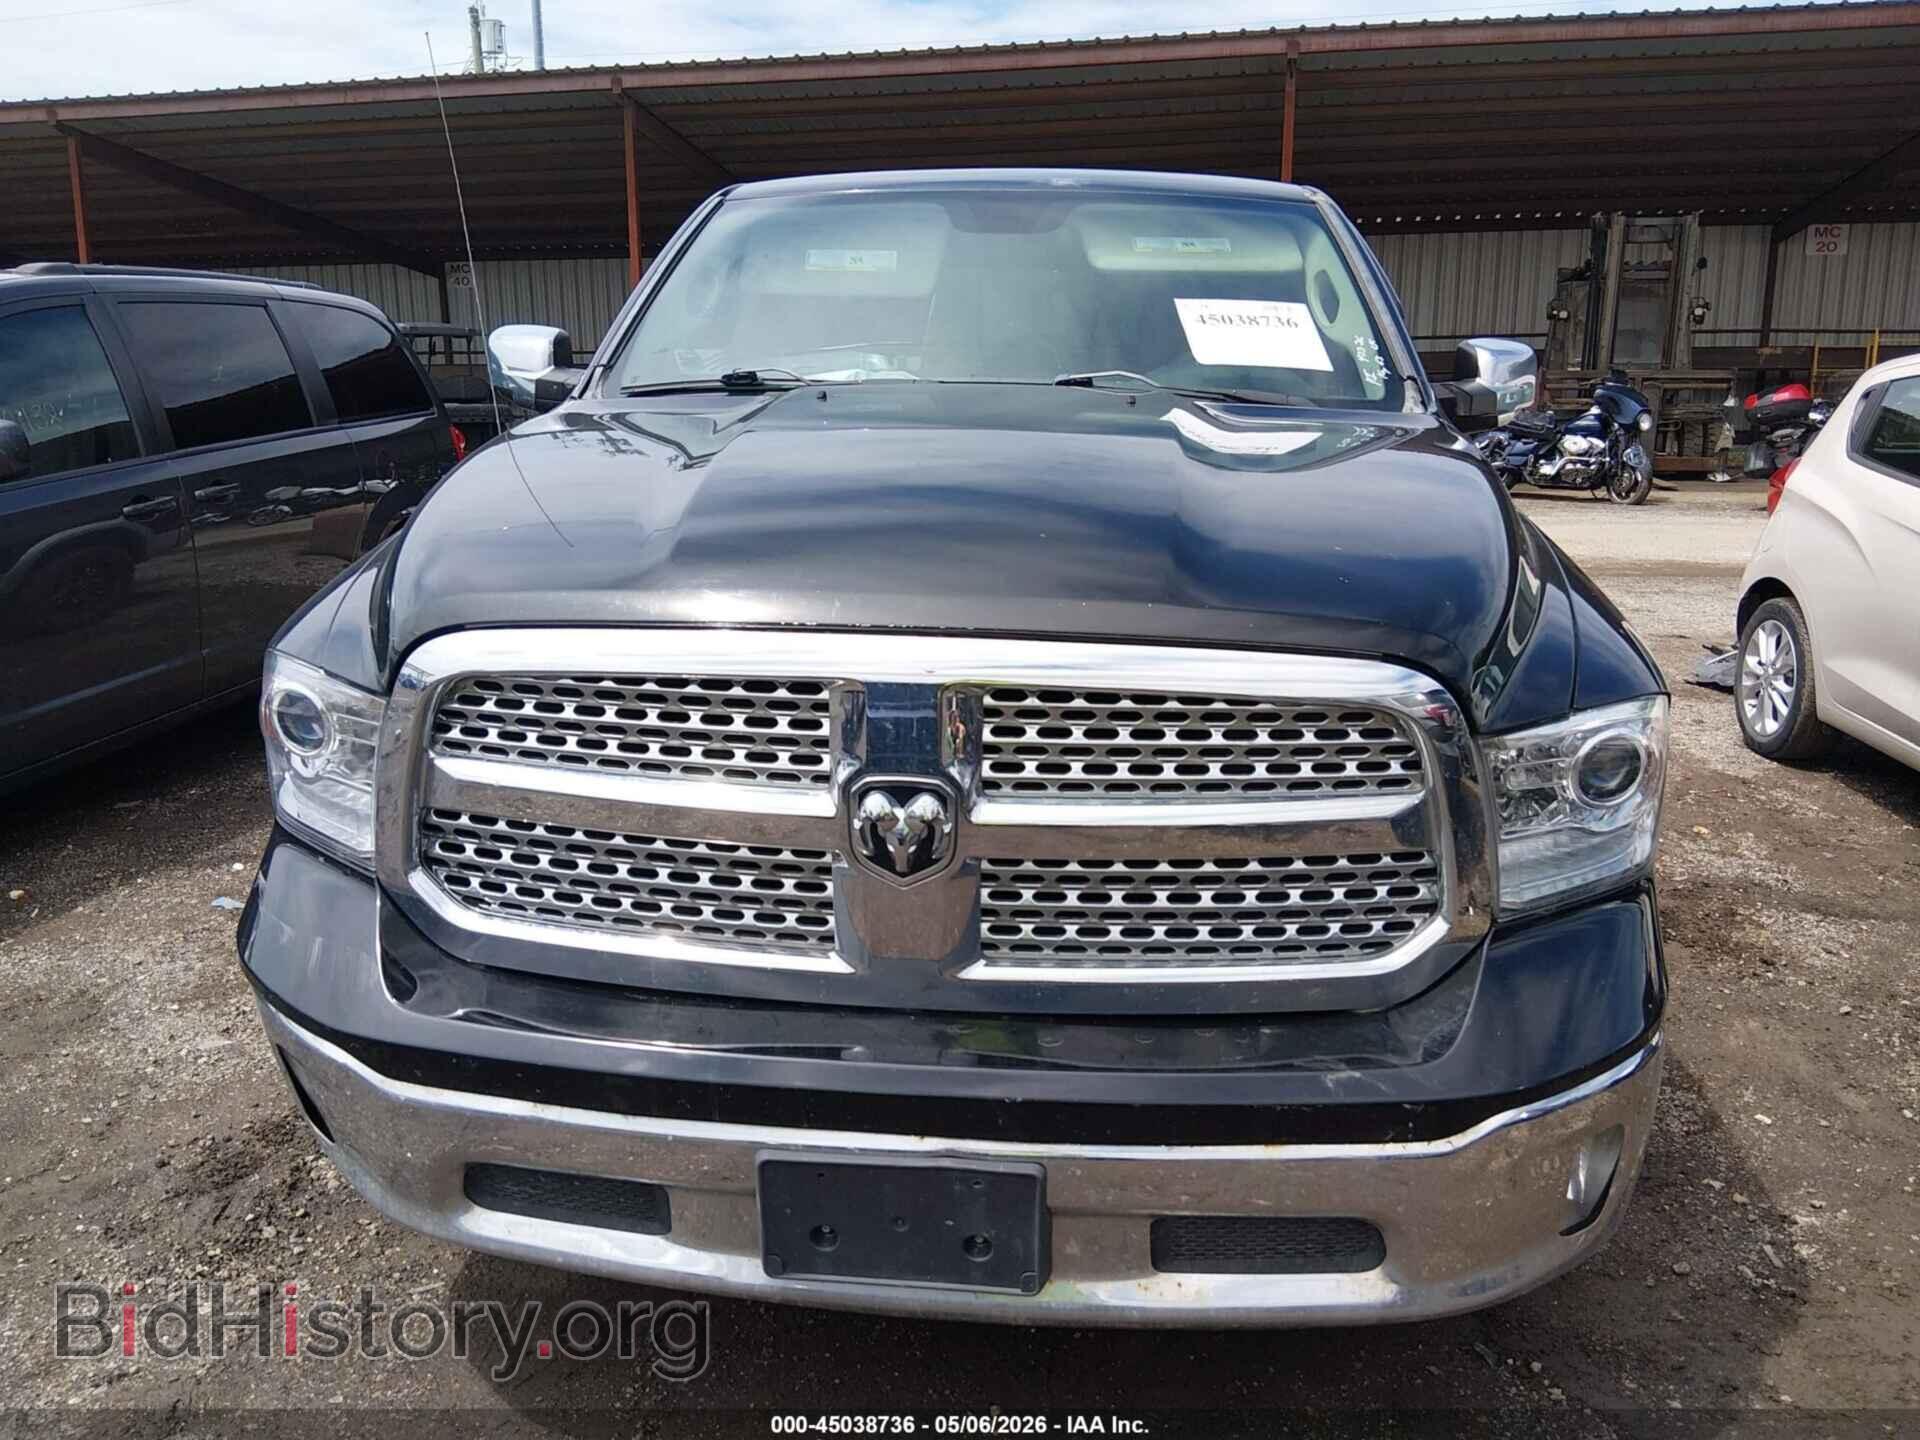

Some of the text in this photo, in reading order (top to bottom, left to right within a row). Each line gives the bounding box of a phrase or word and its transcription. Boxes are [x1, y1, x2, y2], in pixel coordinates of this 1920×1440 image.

[1814, 226, 1842, 239] MC
[1815, 241, 1838, 253] 20
[450, 263, 471, 273] MC
[1195, 313, 1299, 328] 45038736
